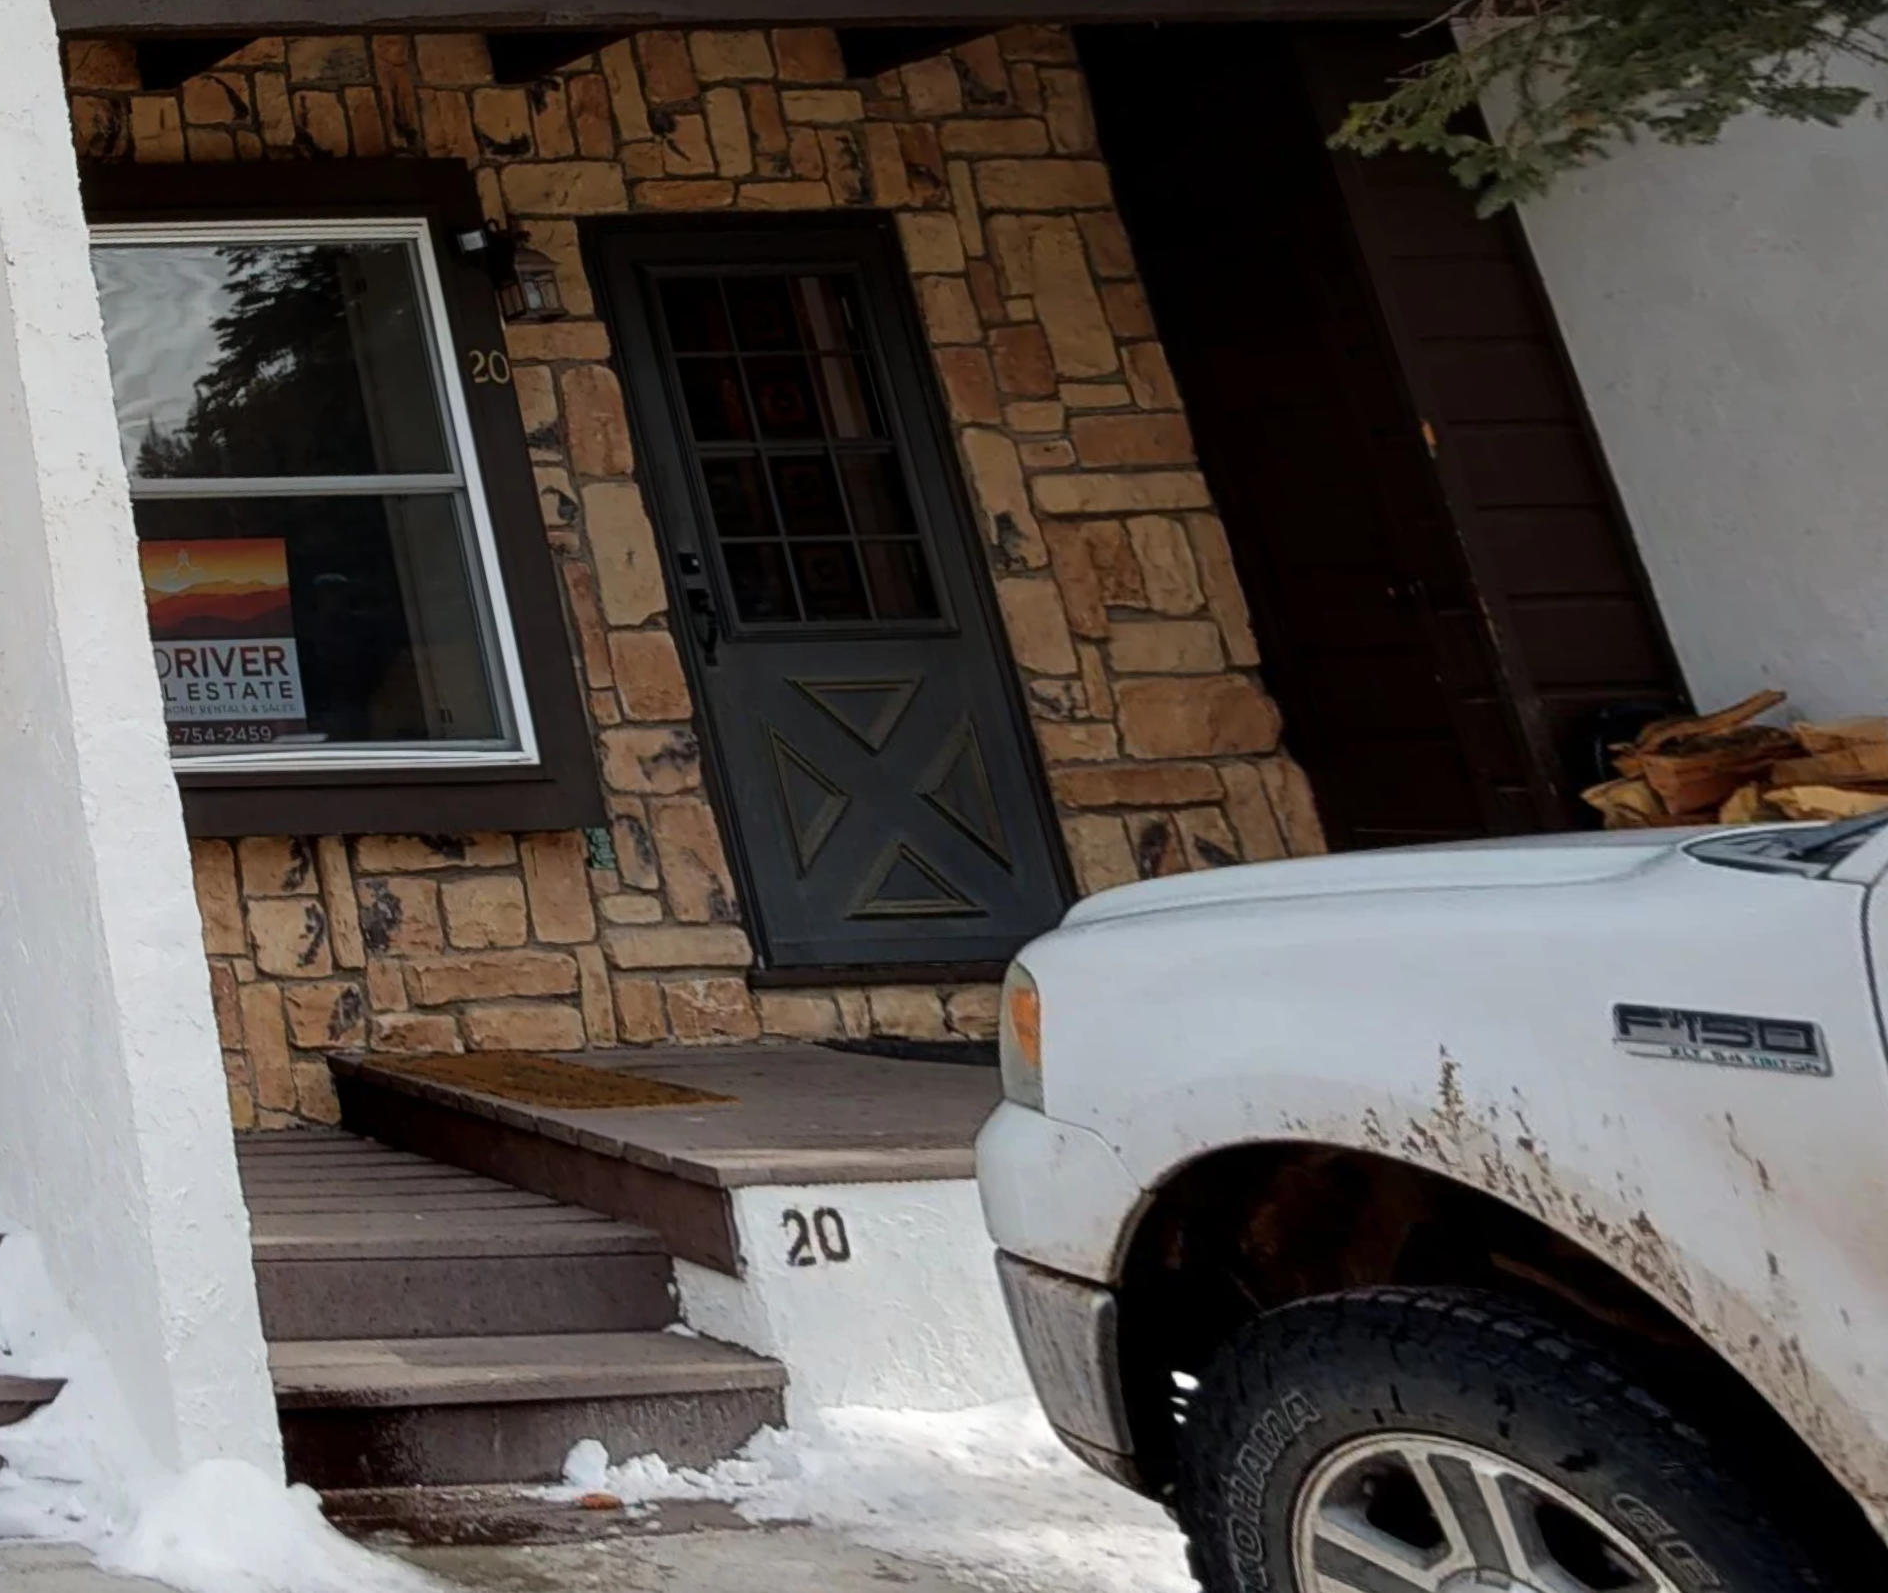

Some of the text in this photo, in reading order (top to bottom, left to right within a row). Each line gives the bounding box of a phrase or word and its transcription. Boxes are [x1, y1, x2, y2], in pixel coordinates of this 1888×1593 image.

[469, 349, 511, 385] 20
[187, 680, 295, 701] ESTATE
[779, 1206, 852, 1267] 20
